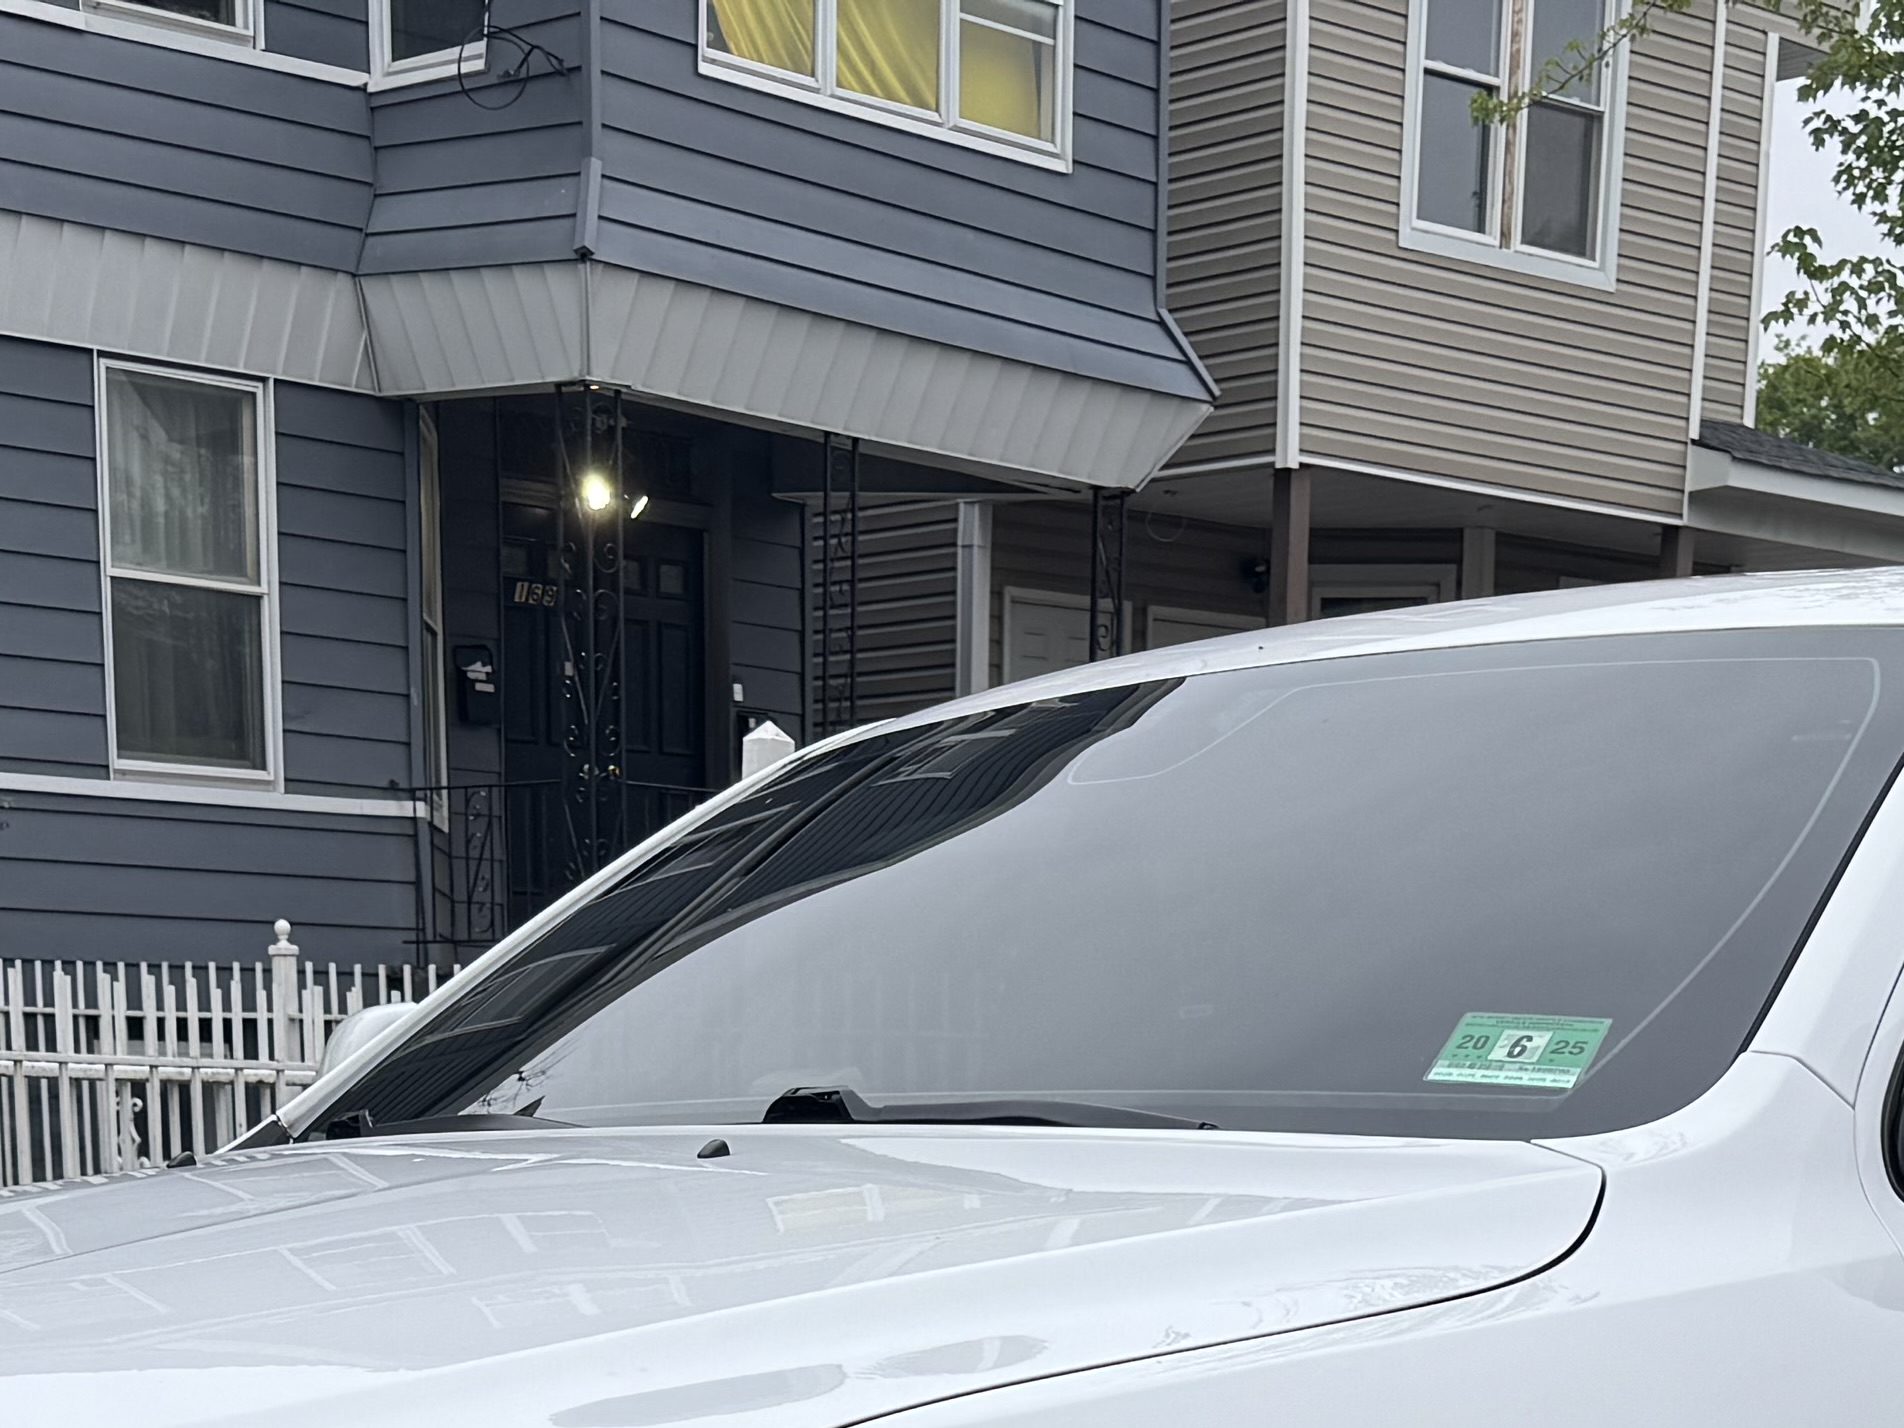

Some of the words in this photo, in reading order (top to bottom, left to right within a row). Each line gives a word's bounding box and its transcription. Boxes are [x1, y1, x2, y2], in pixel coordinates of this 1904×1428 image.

[515, 581, 557, 606] 169
[1455, 1034, 1491, 1051] 20
[1505, 1034, 1534, 1059] 6
[1548, 1040, 1589, 1057] 25
